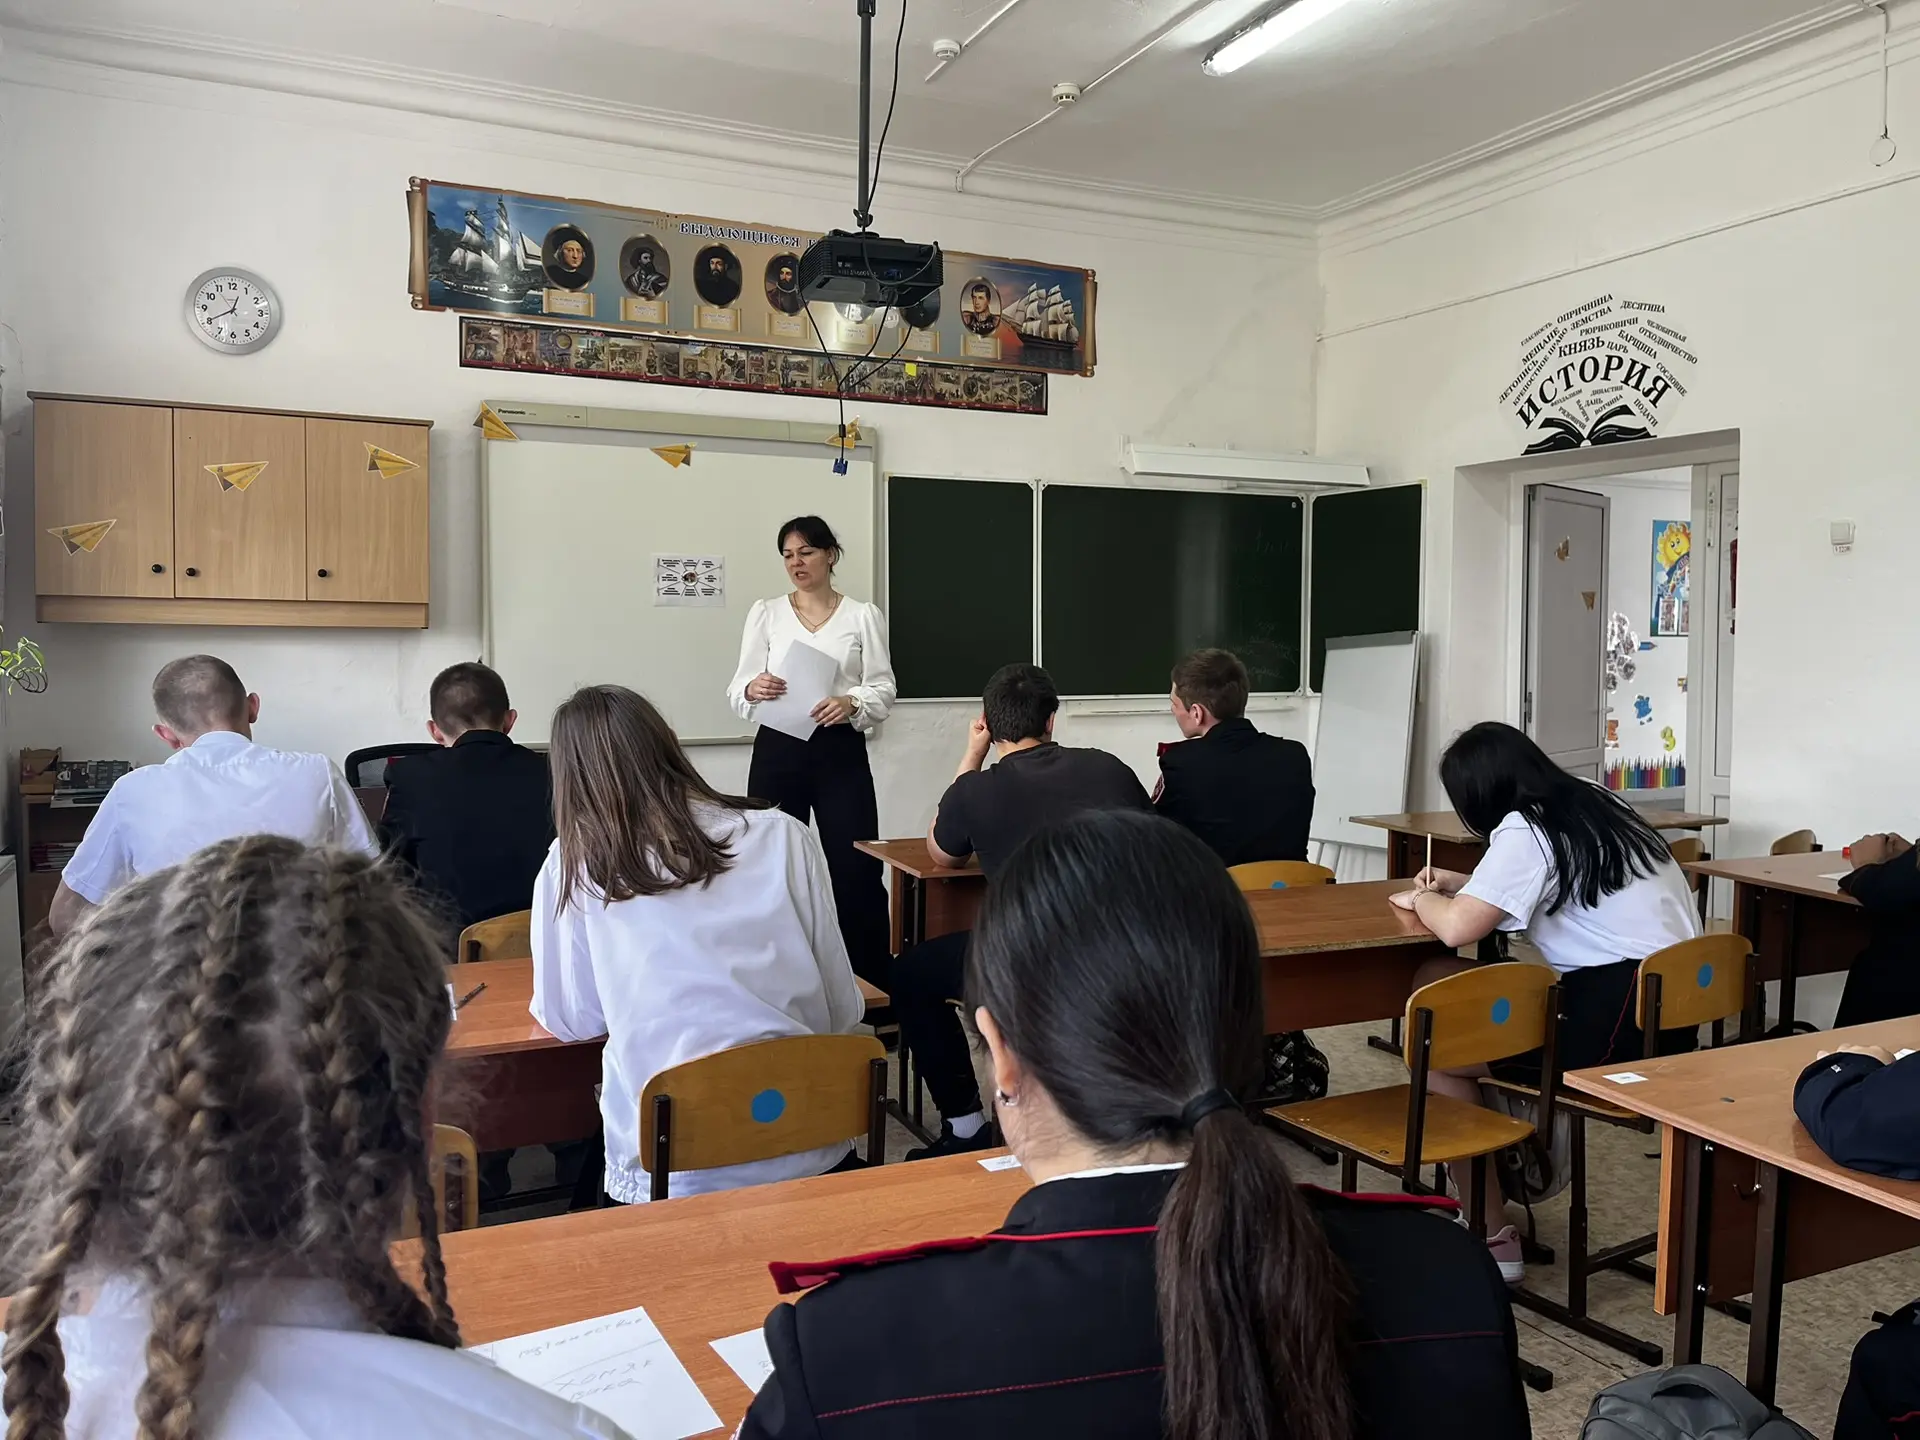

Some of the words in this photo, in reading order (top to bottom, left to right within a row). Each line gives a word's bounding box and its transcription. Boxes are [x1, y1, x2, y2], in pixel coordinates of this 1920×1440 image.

[679, 221, 801, 248] ВЫДАЮЩИЕСЯ
[244, 287, 248, 295] 1
[1556, 293, 1613, 324] ОПРИЧНИНА
[1570, 306, 1612, 331] ЗЕМСТВА
[1620, 300, 1665, 314] ДЕСЯТИНА
[206, 317, 212, 325] 8
[1580, 317, 1638, 337] РЮРИКОВИЧИ
[1647, 319, 1688, 343] ЧЕЛОБИТНАЯ
[1520, 322, 1553, 346] ГЛАСНОСТЬ
[1521, 327, 1561, 366] МЕЩАНЕ
[1618, 329, 1658, 360] БАРЩИНА
[1638, 326, 1698, 364] ОТХОДНИЧЕСТВО
[1558, 336, 1605, 358] КНЯЗЬ
[1607, 341, 1629, 354] ЦАРЬ
[1512, 354, 1550, 406] КРЕПОСТНОЕ
[1548, 328, 1568, 356] ПРАВО
[1656, 362, 1688, 397] СОСЛОВИЕ
[1499, 359, 1539, 404] ЛЕТОПИСЬ
[1515, 354, 1672, 429] ИСТОРИЯ
[1584, 398, 1604, 407] ДАНЬ
[1594, 394, 1623, 415] ВОТЧИНА
[1633, 398, 1659, 428] ПОДАТИ
